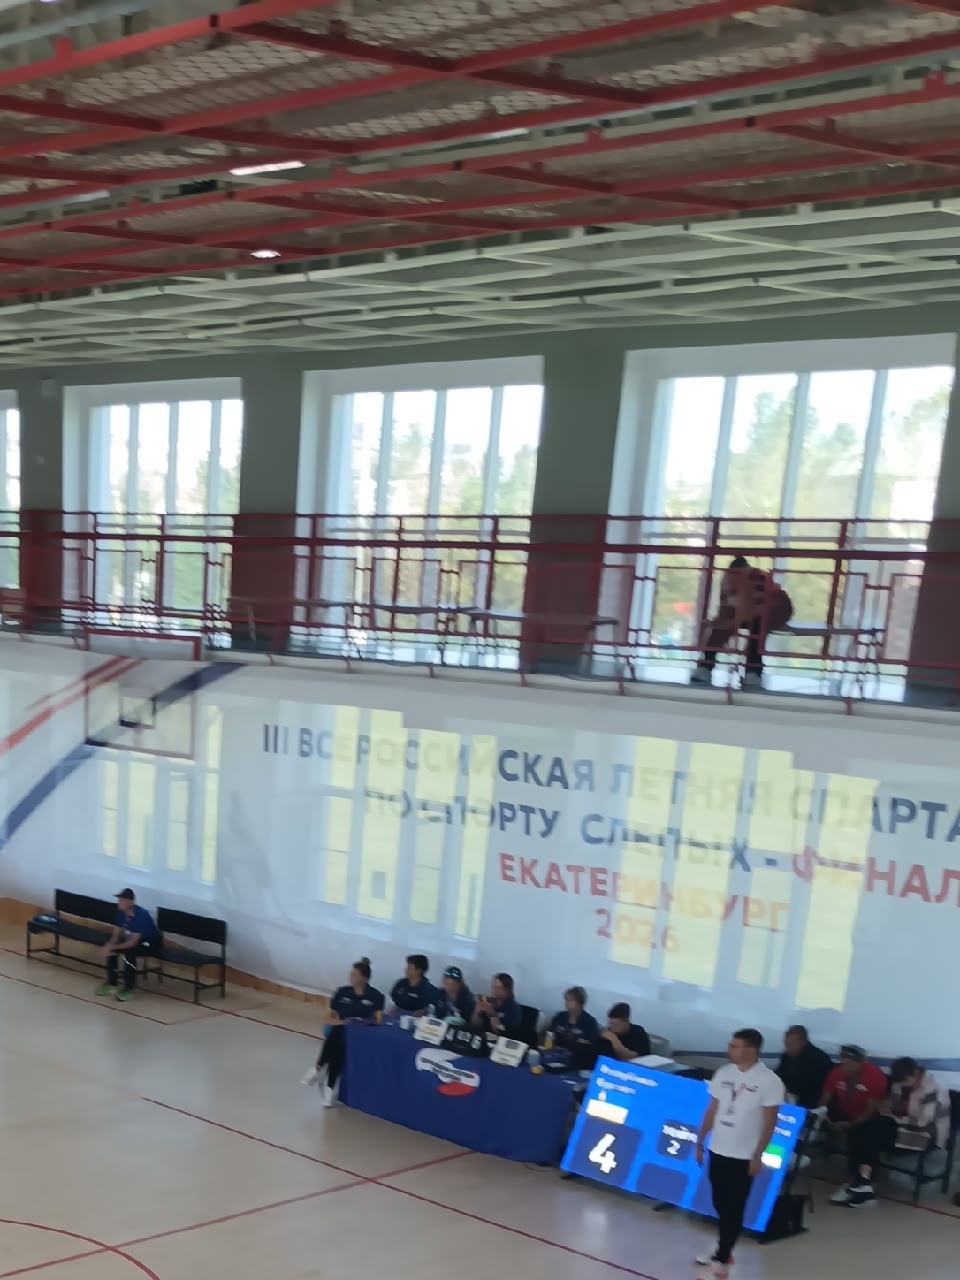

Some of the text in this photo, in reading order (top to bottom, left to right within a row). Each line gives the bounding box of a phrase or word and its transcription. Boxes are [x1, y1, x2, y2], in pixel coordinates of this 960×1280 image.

[299, 727, 595, 792] ВСЕРОССИЙСКАЯ
[610, 763, 772, 817] ЛЕТНЯЯ
[499, 852, 790, 933] ЕКАТЕРИНБУРГ
[595, 908, 680, 951] 2026
[589, 1133, 617, 1174] 4
[667, 1139, 681, 1155] 2
